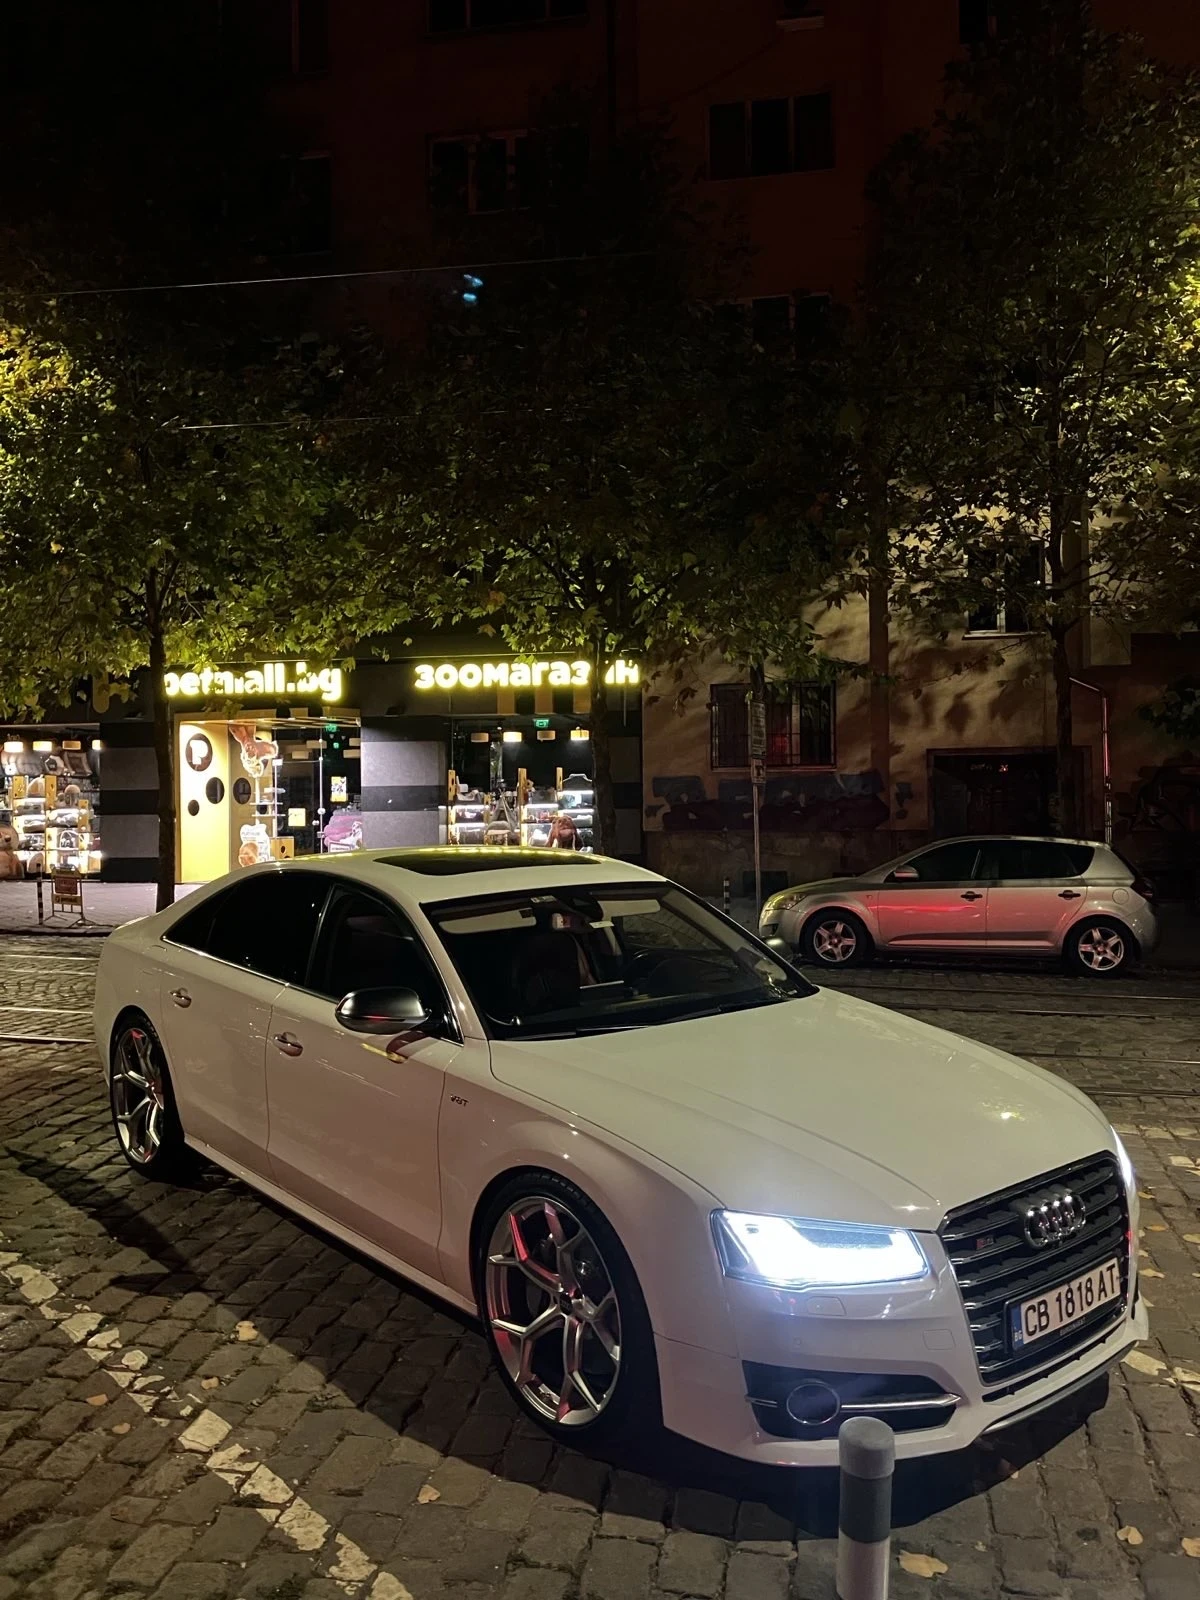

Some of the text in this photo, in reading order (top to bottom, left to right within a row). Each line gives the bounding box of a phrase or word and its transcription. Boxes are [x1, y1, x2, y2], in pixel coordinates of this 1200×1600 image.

[1025, 1263, 1116, 1337] CB 1818 AT
[1014, 1330, 1023, 1342] BG
